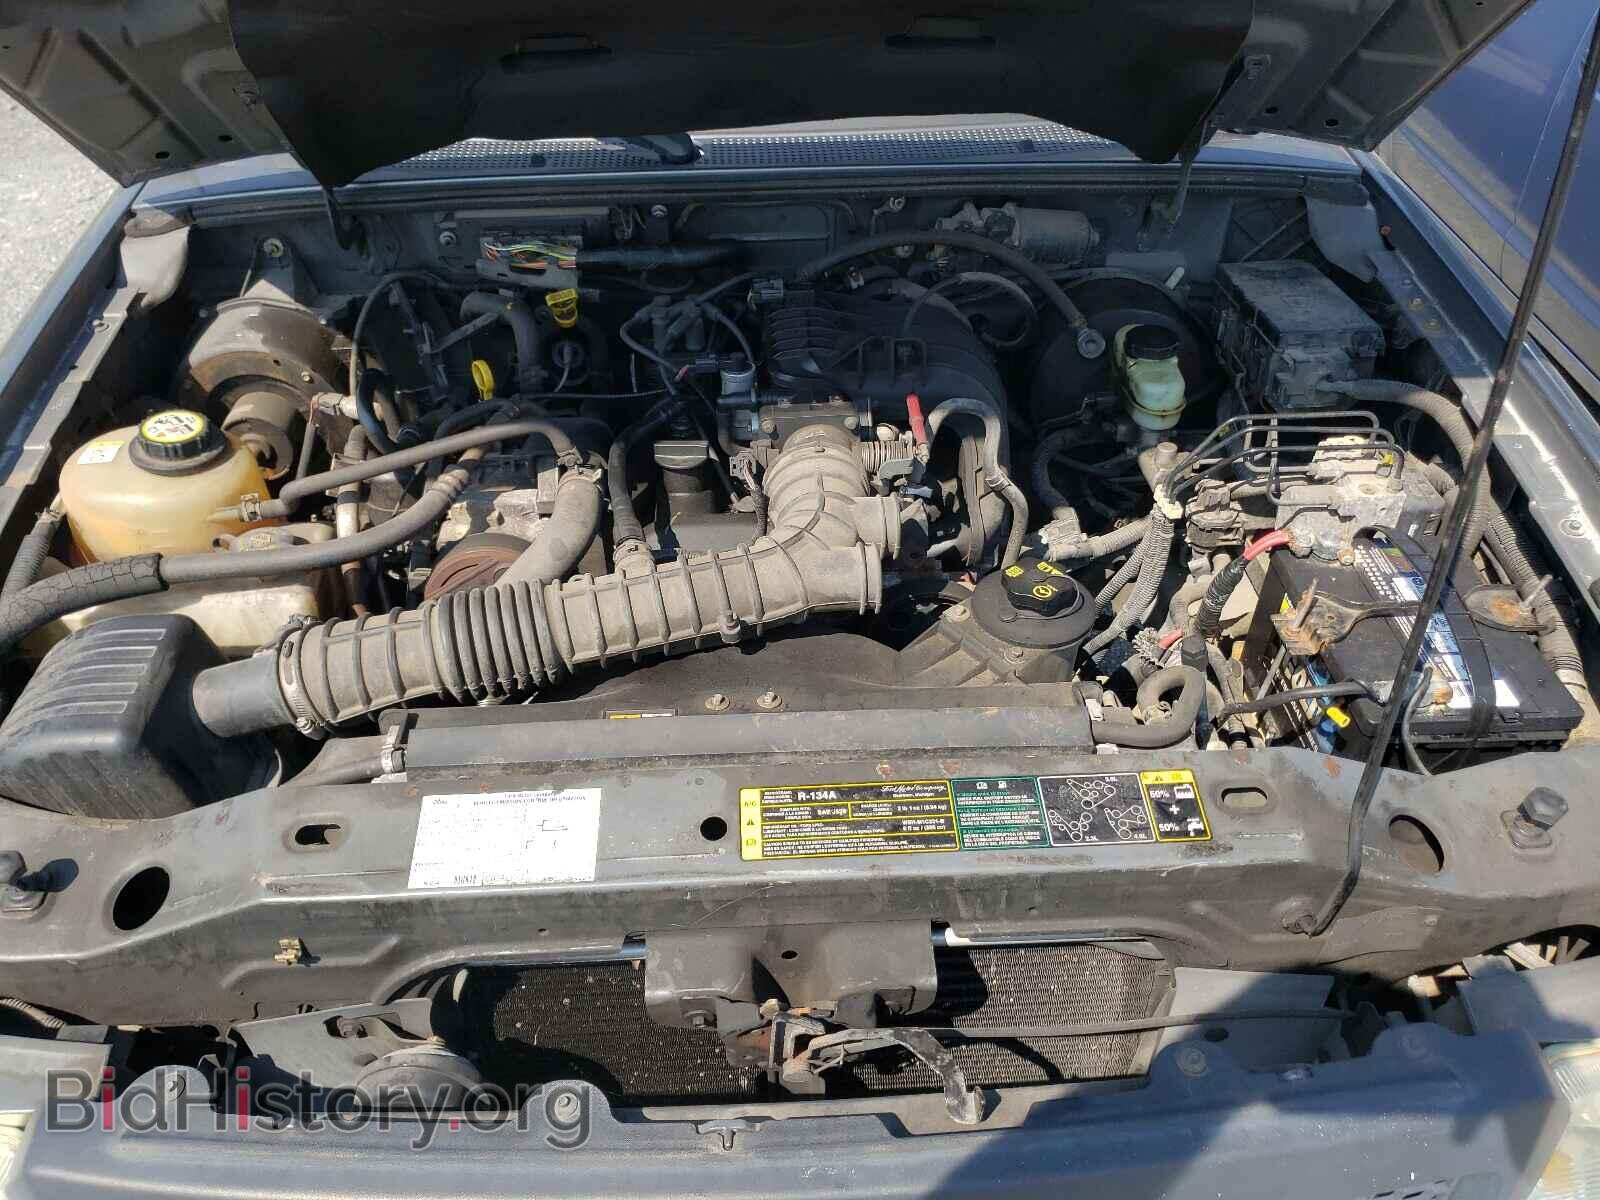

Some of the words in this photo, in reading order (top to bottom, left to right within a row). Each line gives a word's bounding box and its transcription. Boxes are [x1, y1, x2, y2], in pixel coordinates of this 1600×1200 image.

[797, 790, 837, 800] R-134A
[1149, 790, 1170, 799] 50%
[1158, 822, 1180, 832] 50%
